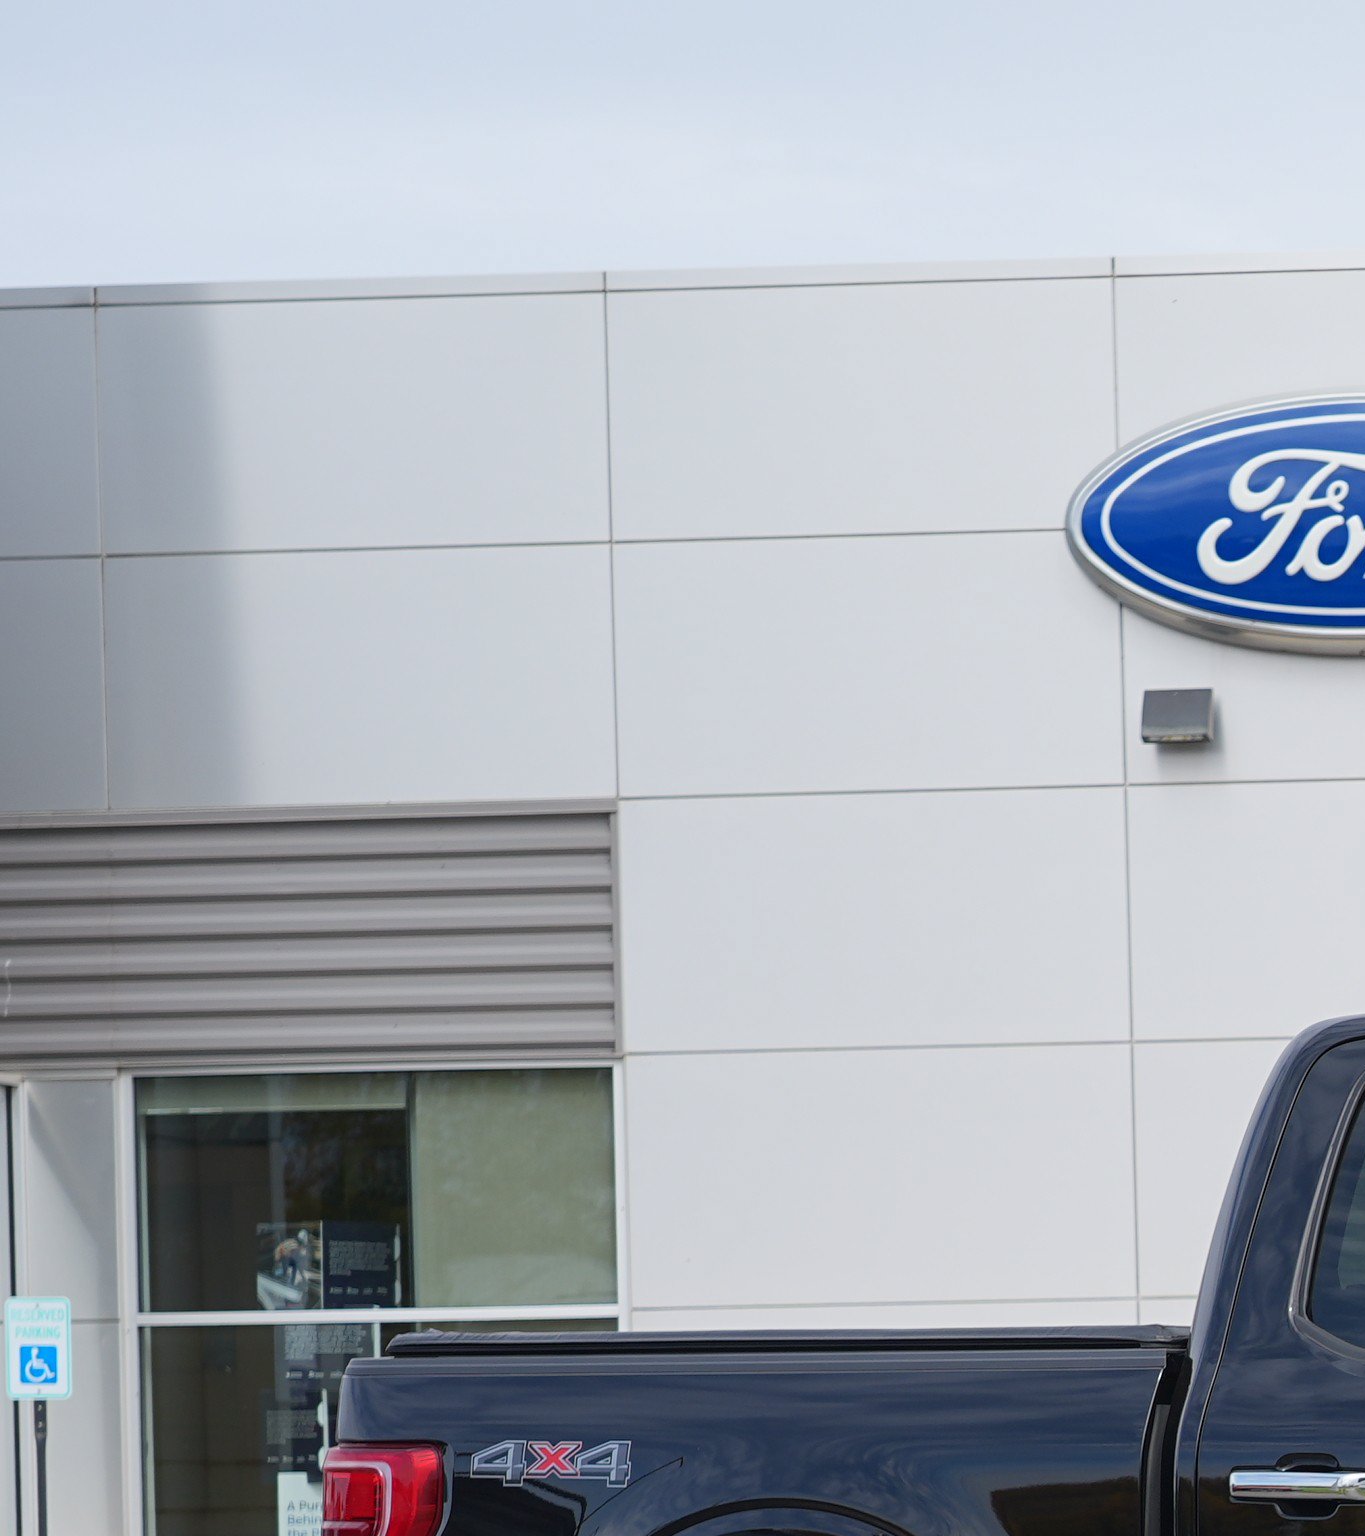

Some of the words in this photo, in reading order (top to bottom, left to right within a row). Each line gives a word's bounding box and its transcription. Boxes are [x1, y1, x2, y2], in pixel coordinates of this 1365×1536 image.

[11, 1309, 65, 1321] RESERVED
[15, 1327, 61, 1339] PARKING
[287, 1500, 295, 1511] A
[299, 1500, 323, 1511] Pur
